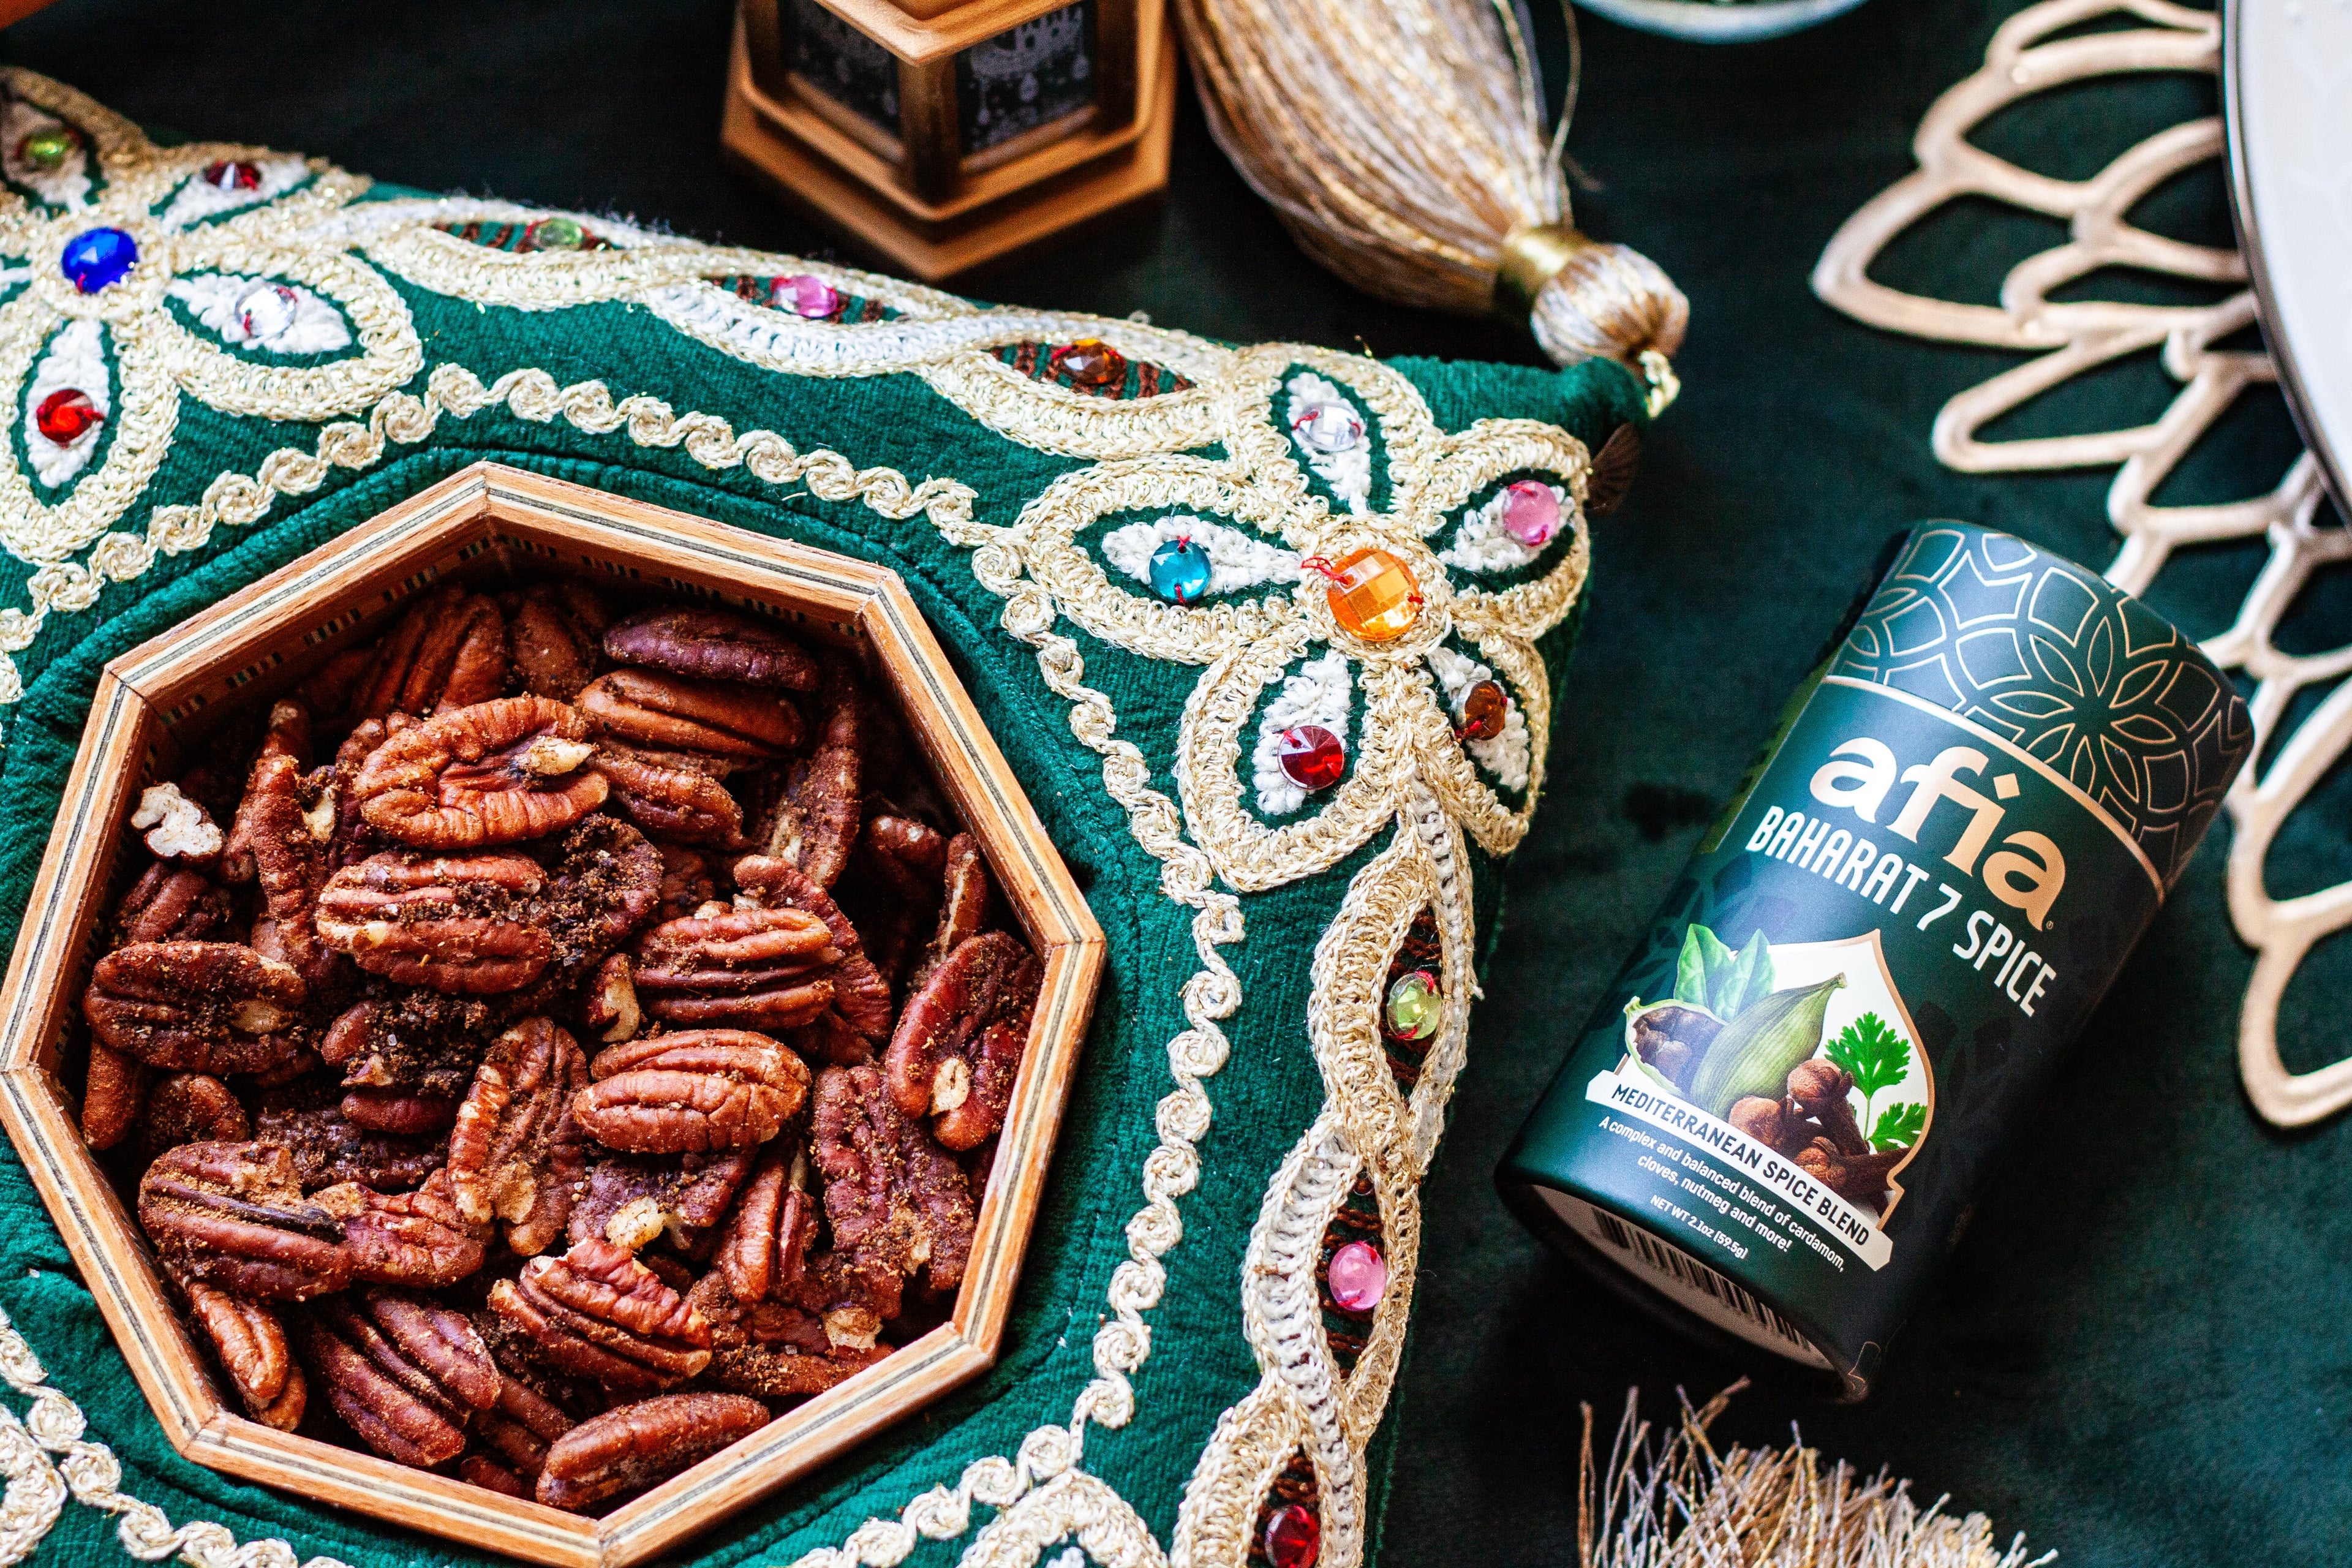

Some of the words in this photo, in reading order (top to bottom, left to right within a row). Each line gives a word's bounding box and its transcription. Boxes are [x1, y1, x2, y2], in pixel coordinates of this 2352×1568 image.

[1746, 805, 1929, 914] BAHARAT
[1917, 883, 1962, 931] 7
[1953, 910, 2057, 1017] SPICE
[1810, 737, 2065, 931] afia
[1599, 1115, 1610, 1129] A
[1609, 1121, 1657, 1149] complex
[1657, 1143, 1683, 1161] and
[1681, 1152, 1741, 1194] balanced
[1738, 1186, 1776, 1217] blend
[1774, 1212, 1792, 1226] of
[1788, 1221, 1845, 1272] cardamom,
[1611, 1084, 1763, 1169] MEDITERRANEAN
[1763, 1161, 1819, 1206] SPICE
[1816, 1197, 1869, 1246] BLEND
[1637, 1155, 1679, 1185] cloves,
[1680, 1177, 1731, 1214] nutmeg
[1730, 1207, 1757, 1228] and
[1755, 1223, 1793, 1252] more!
[1650, 1194, 1673, 1212] NET
[1671, 1205, 1691, 1221] WT
